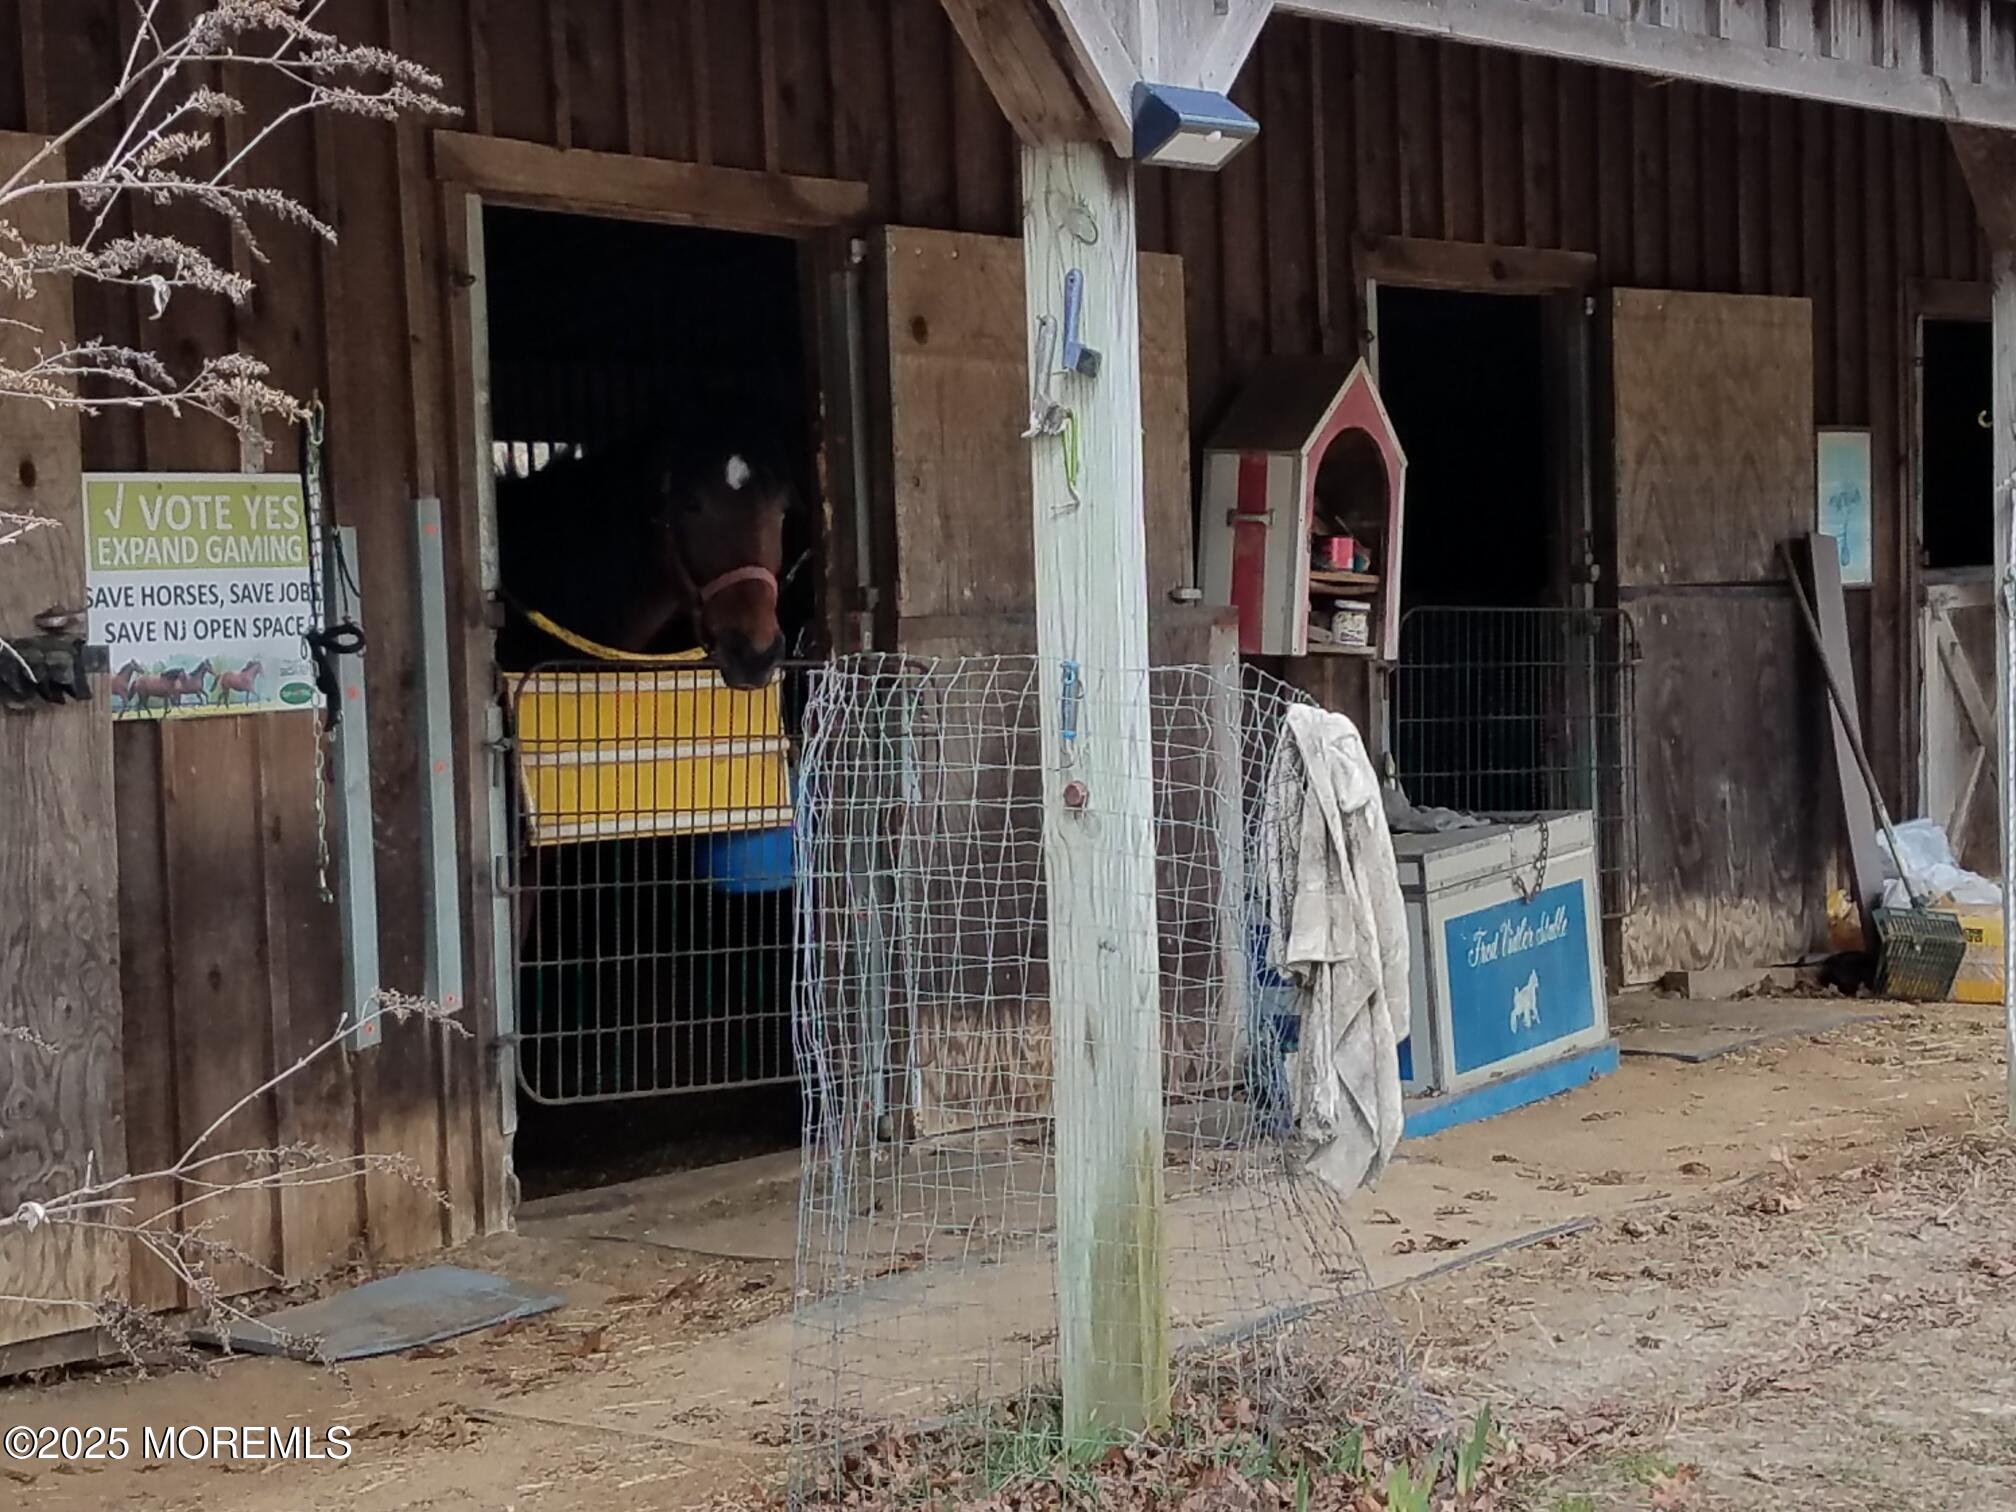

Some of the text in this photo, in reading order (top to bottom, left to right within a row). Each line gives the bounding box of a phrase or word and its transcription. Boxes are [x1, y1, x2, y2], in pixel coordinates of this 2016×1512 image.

[138, 494, 301, 531] VOTE YES
[97, 535, 302, 566] EXPAND GAMING
[85, 581, 314, 609] SAVE HORSES, SAVE JOB
[104, 621, 157, 644] SAVE
[193, 618, 247, 641] OPEN
[252, 616, 305, 638] SPACE
[1467, 927, 1499, 967] Fred
